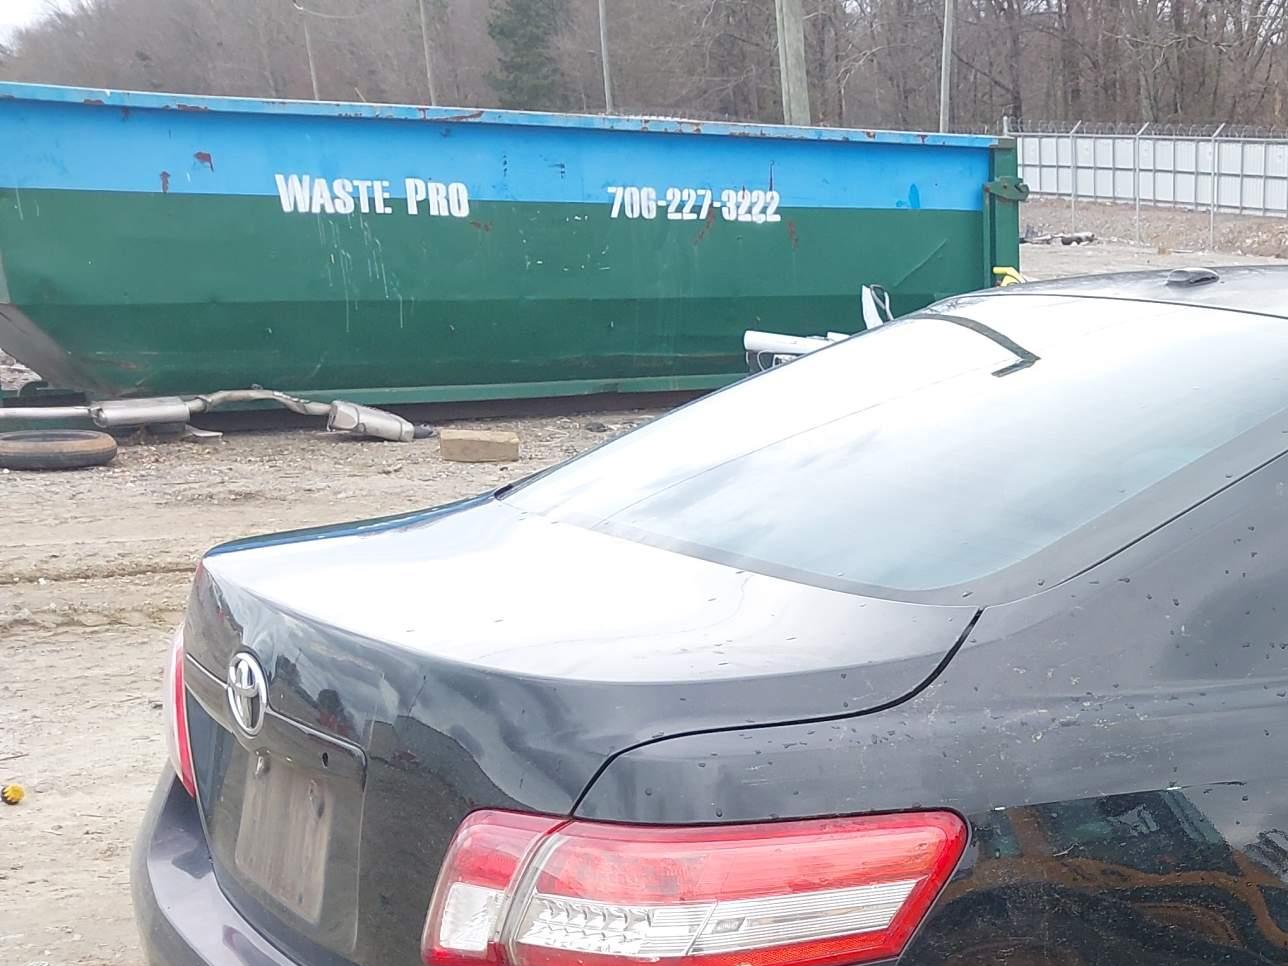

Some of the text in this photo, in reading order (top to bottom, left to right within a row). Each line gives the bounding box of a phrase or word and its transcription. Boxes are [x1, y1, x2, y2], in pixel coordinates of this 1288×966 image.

[274, 174, 470, 217] WASTE PRO
[607, 186, 781, 223] 706-227-3222
